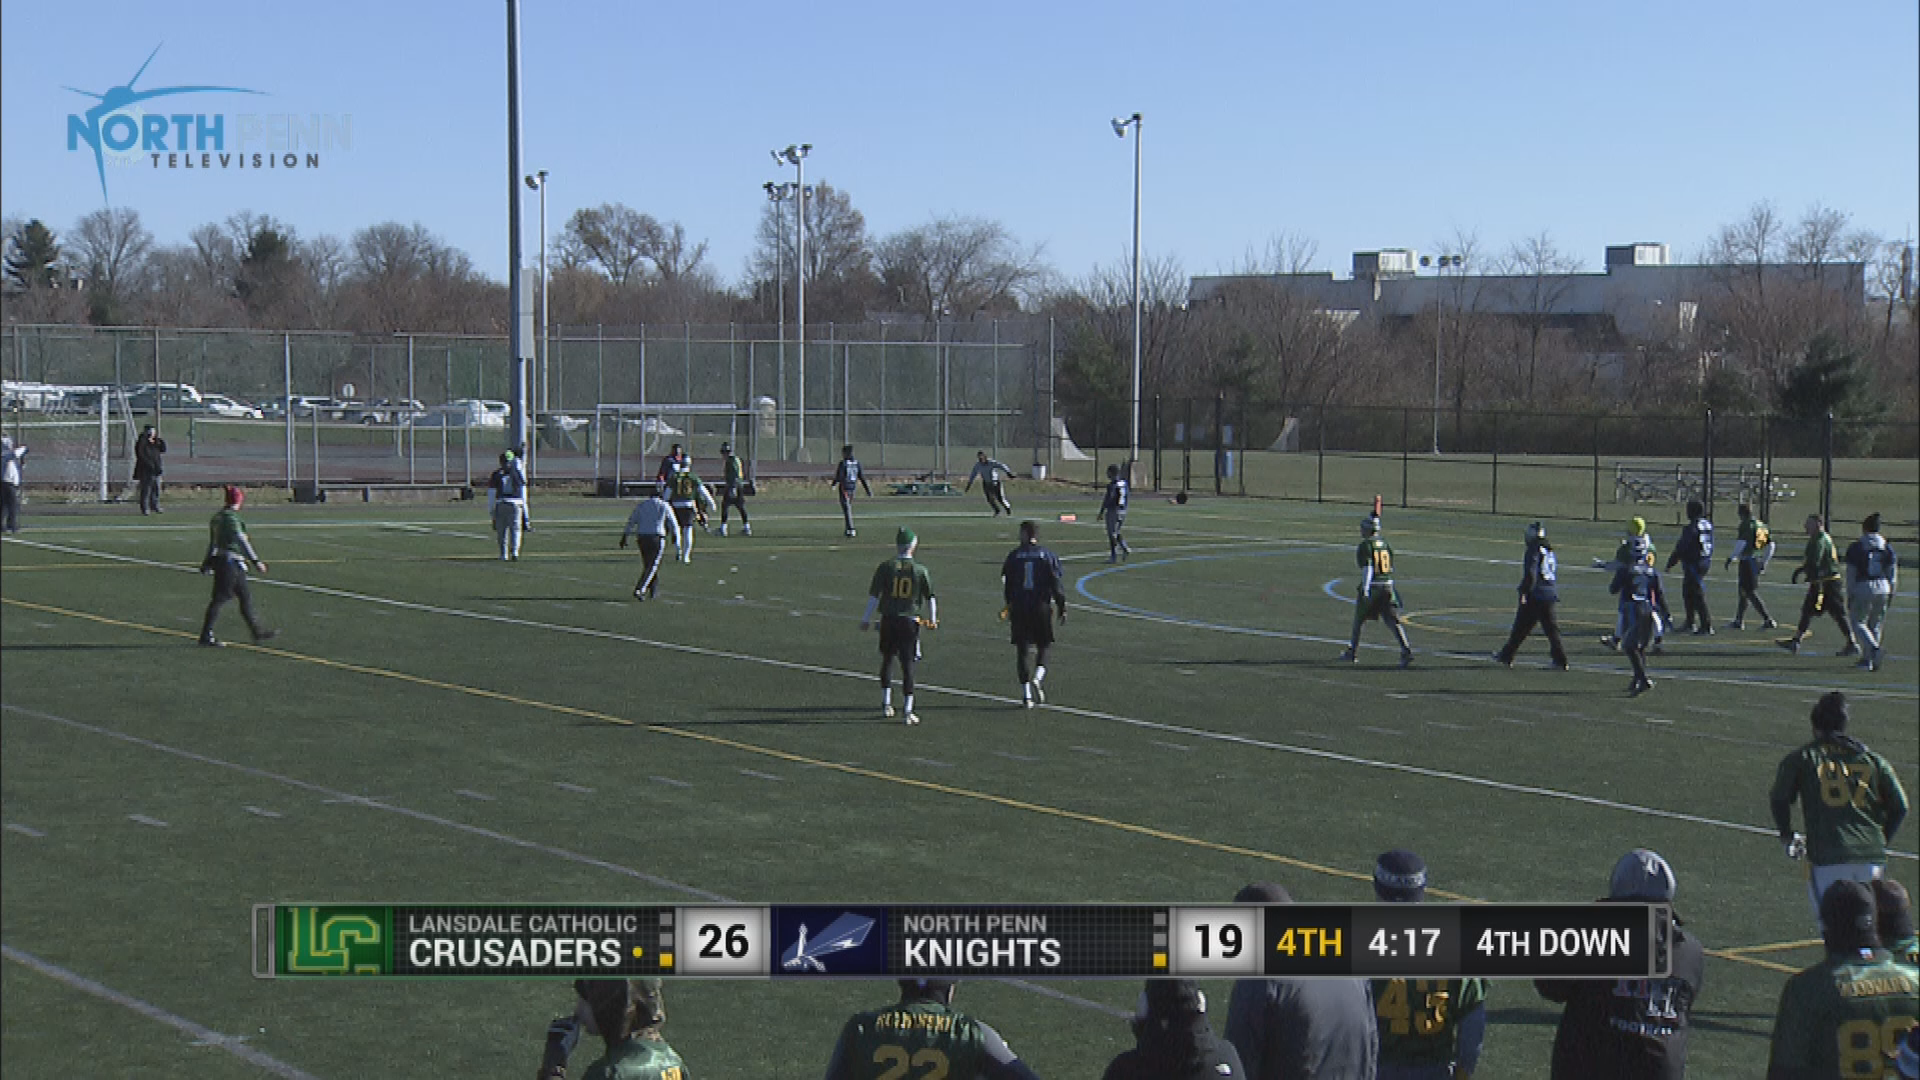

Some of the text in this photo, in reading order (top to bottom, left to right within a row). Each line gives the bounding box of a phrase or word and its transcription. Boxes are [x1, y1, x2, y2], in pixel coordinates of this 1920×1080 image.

[891, 577, 913, 599] 10
[1817, 763, 1872, 809] 87
[1376, 978, 1450, 1036] 43
[873, 1044, 950, 1080] 22
